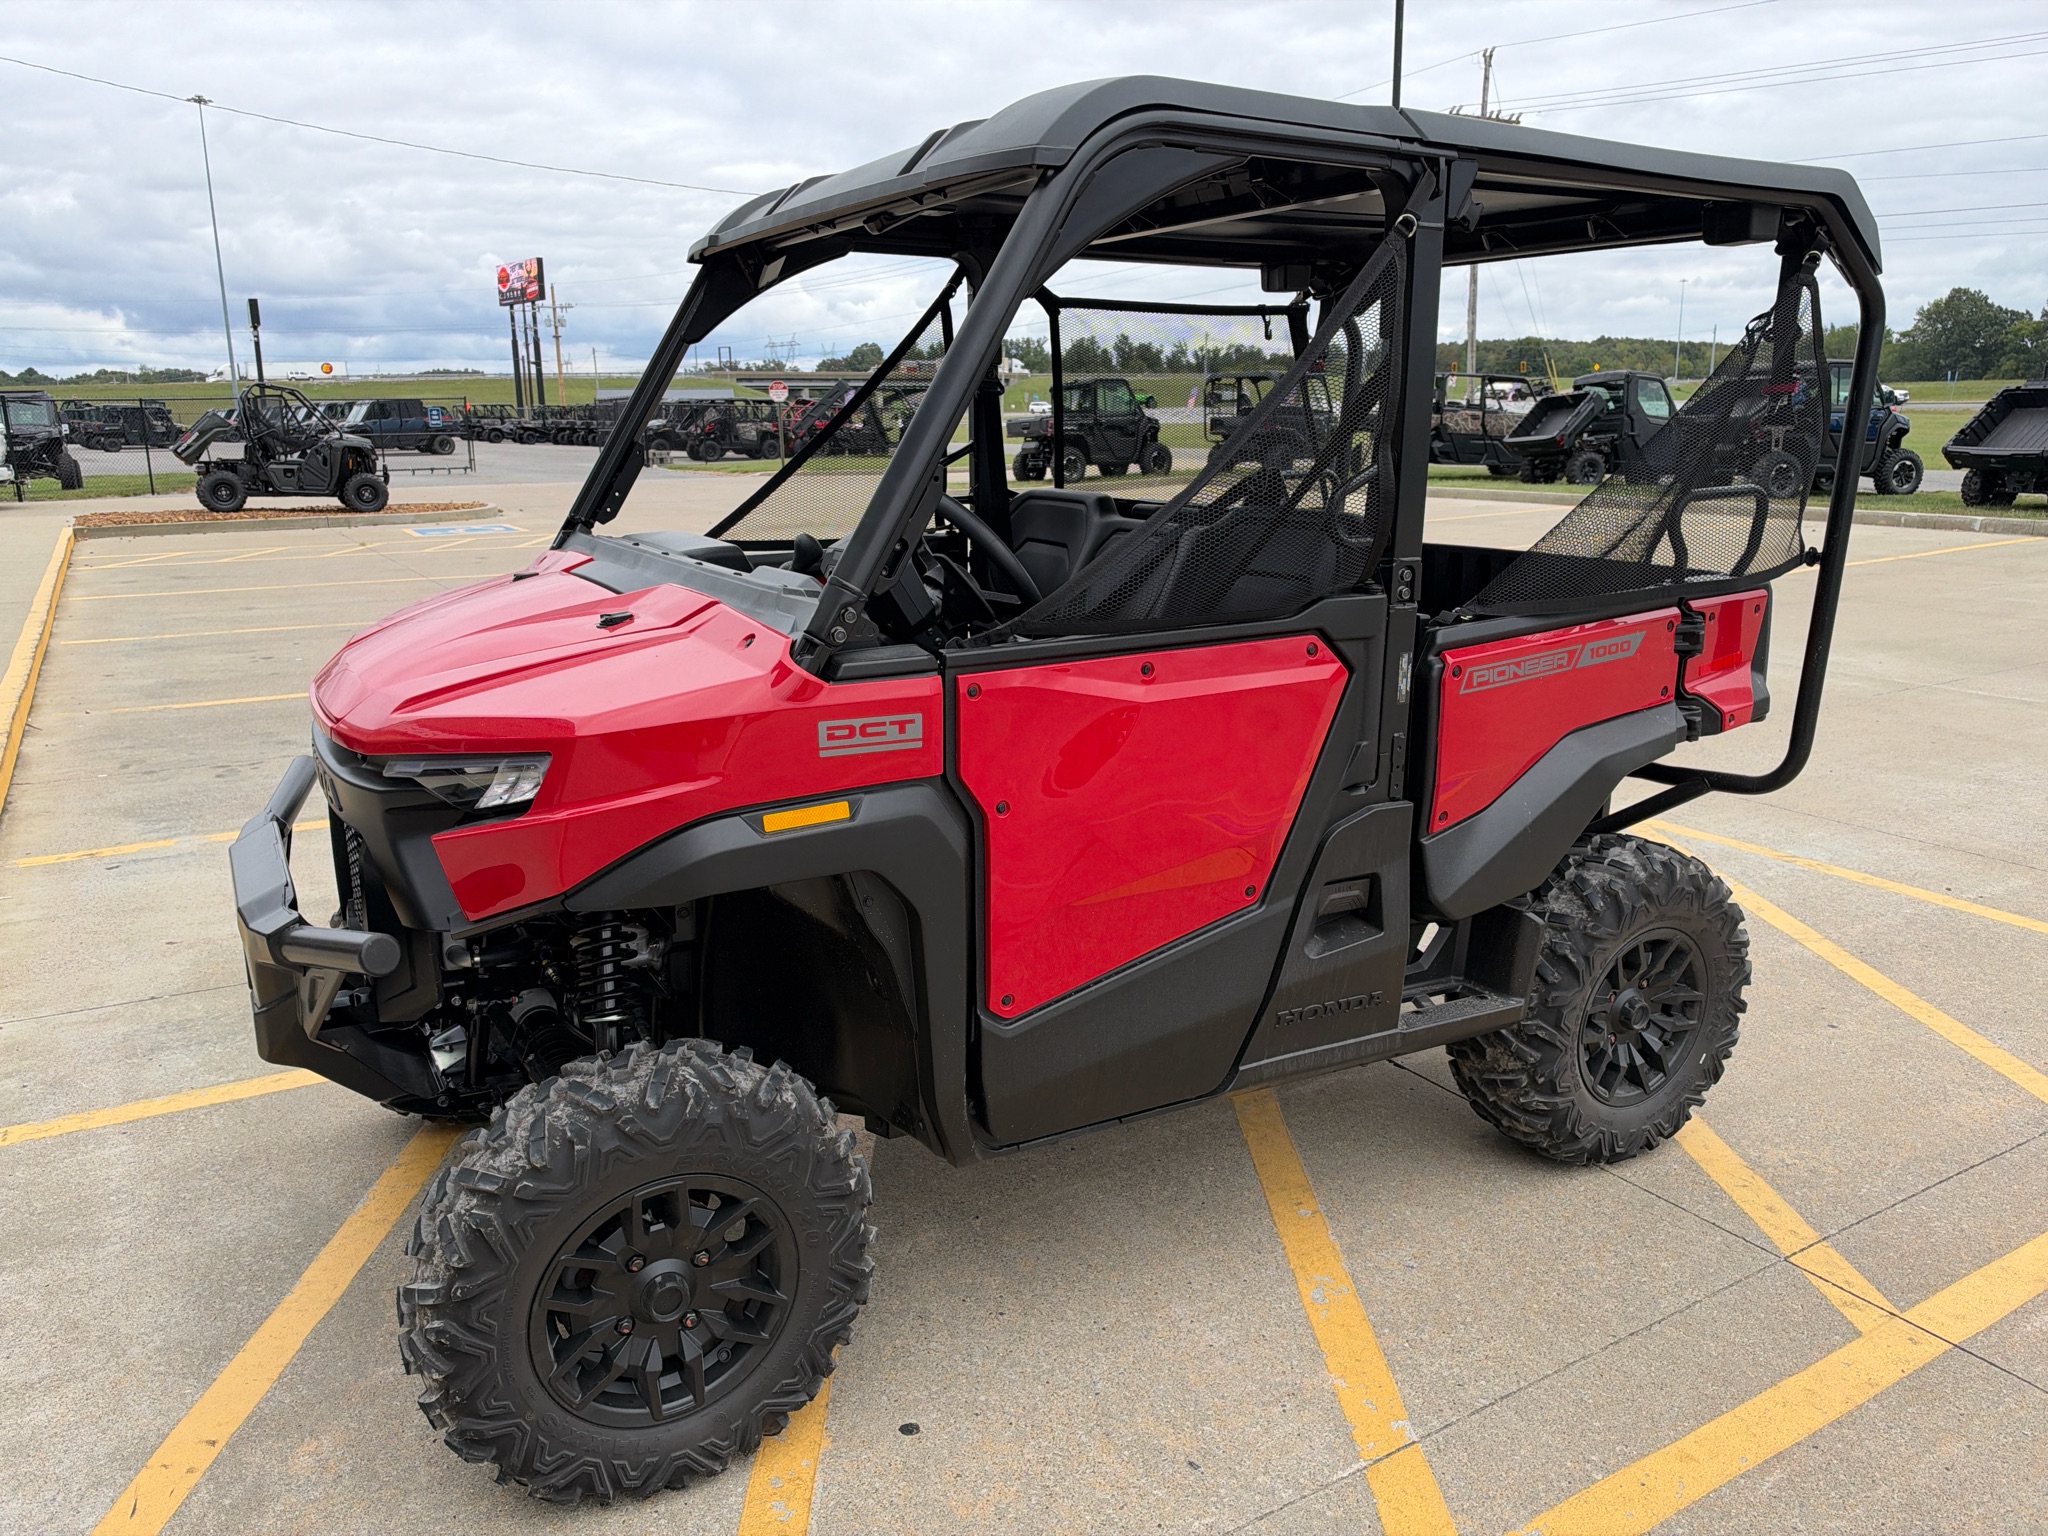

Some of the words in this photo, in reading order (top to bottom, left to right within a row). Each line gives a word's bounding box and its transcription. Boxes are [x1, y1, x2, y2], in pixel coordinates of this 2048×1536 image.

[1473, 653, 1569, 687] PIONEER
[1589, 640, 1632, 660] 1000
[826, 718, 916, 742] DCT
[1275, 990, 1384, 1028] HONDA
